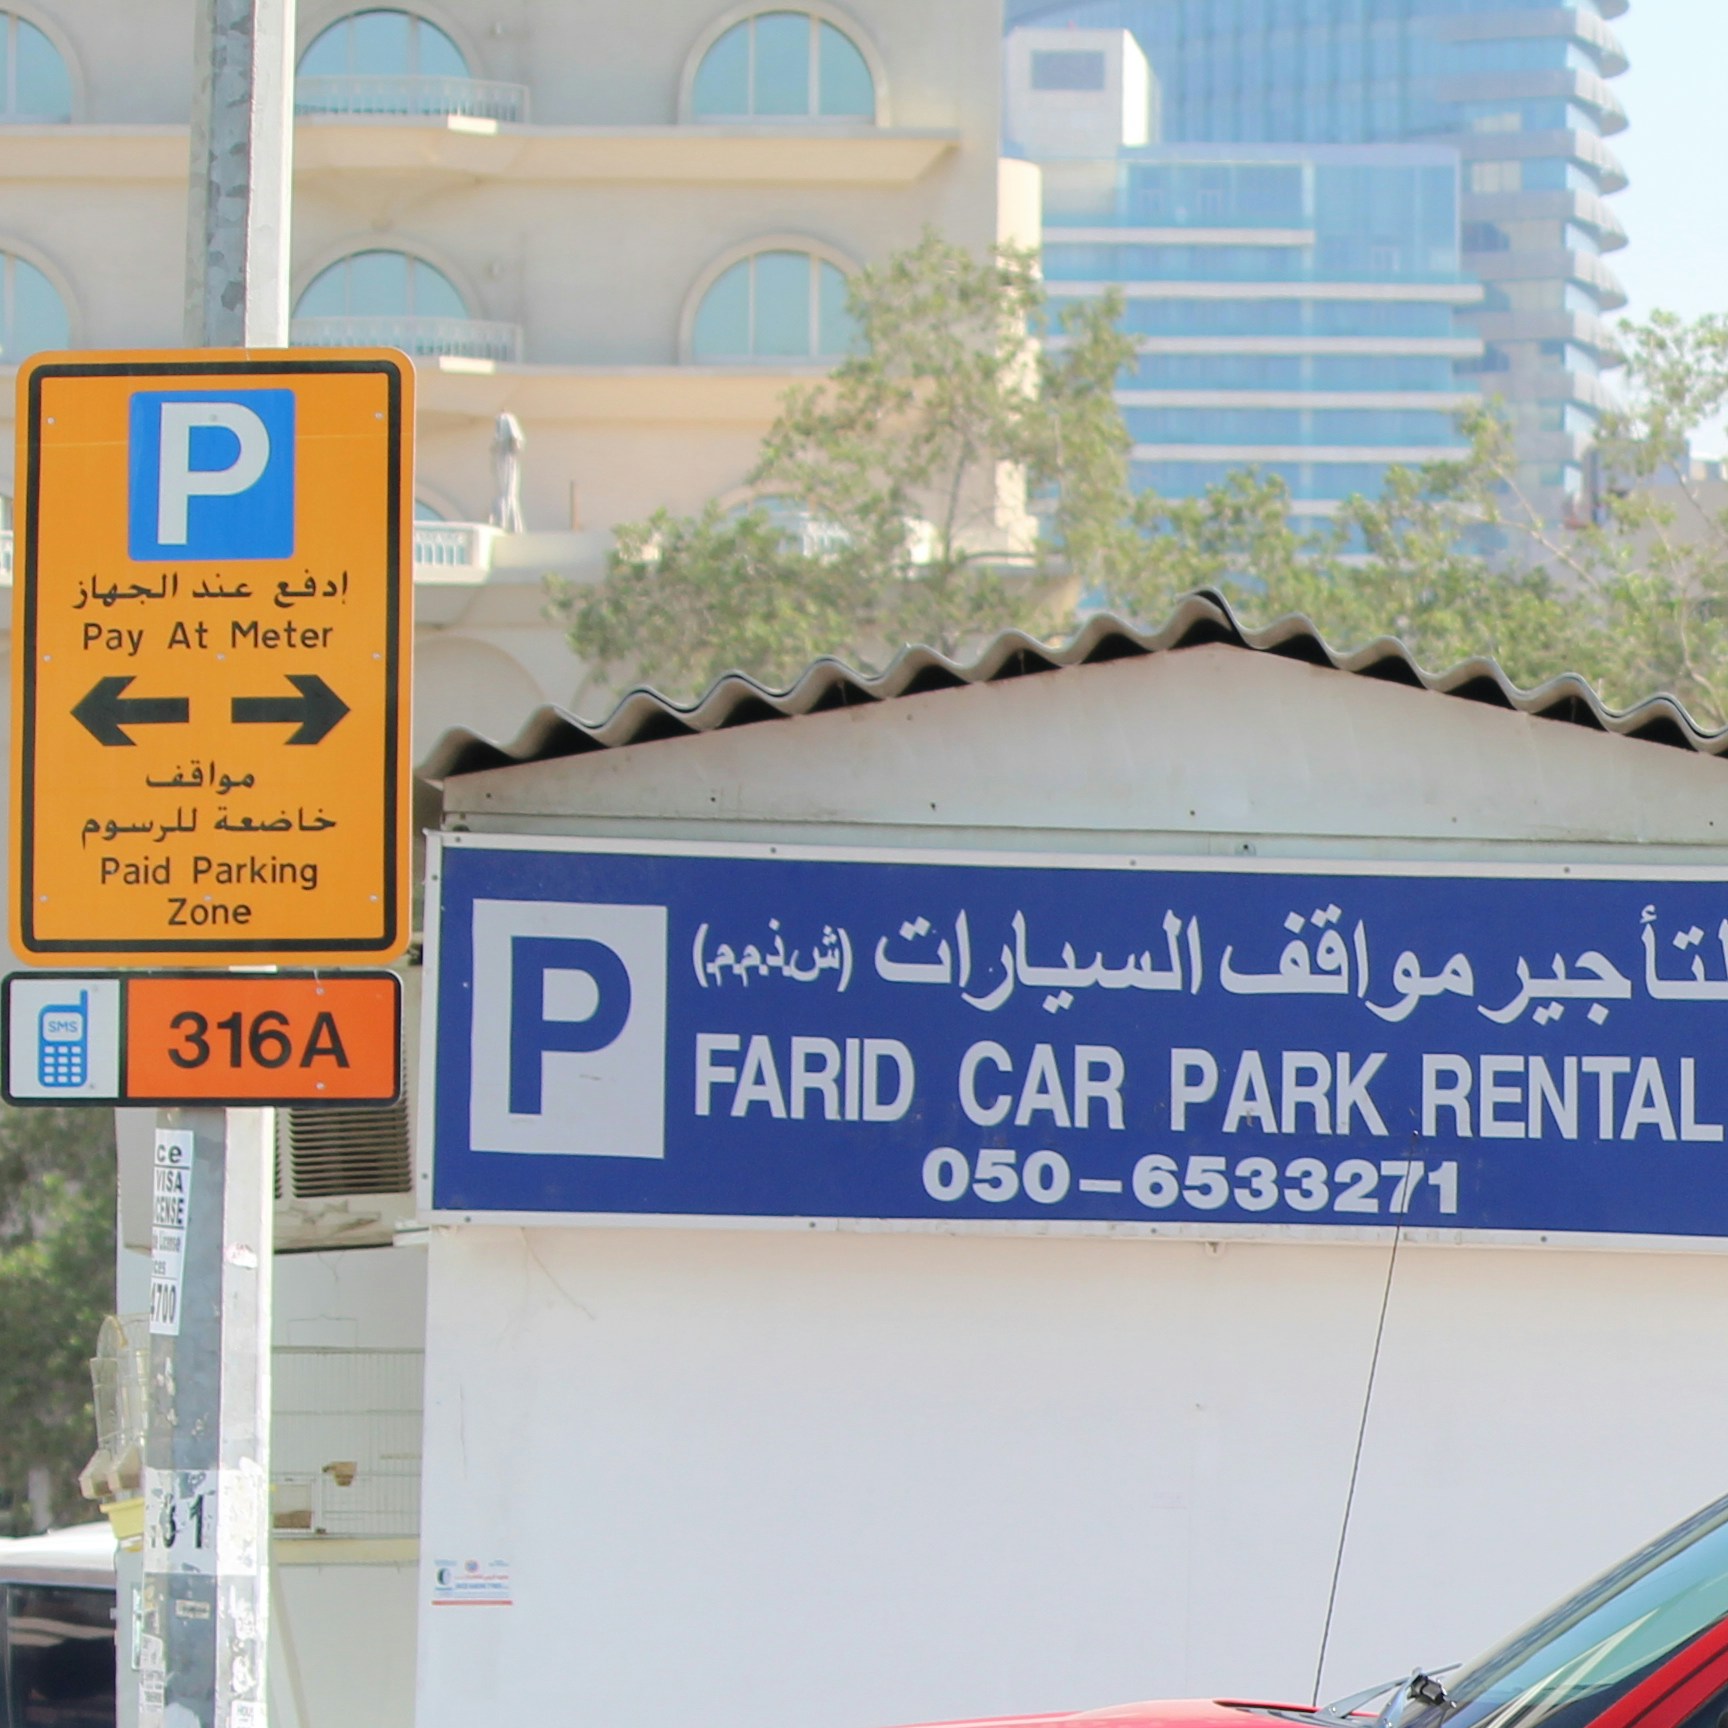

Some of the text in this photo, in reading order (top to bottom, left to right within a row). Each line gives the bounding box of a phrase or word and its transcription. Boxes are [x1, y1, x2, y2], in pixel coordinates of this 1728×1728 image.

[158, 402, 270, 545] P
[72, 571, 179, 609] الجهاز
[192, 573, 253, 599] عند
[83, 620, 334, 656] Pay At Meter
[145, 760, 255, 795] مواقف
[81, 806, 337, 848] خاضعة للرسوم
[101, 856, 318, 890] Paid Parking
[168, 898, 252, 926] Zone
[874, 909, 1202, 1013] السيارات
[1219, 903, 1474, 1023] مواقف
[48, 1020, 78, 1033] SMS
[168, 1011, 350, 1069] 316A
[508, 935, 632, 1115] P
[695, 1032, 915, 1122] FARID
[958, 1040, 1126, 1130] CAR
[1170, 1047, 1389, 1137] PARK
[1415, 1053, 1724, 1142] RENTAL
[922, 1147, 1459, 1214] 050-6533271
